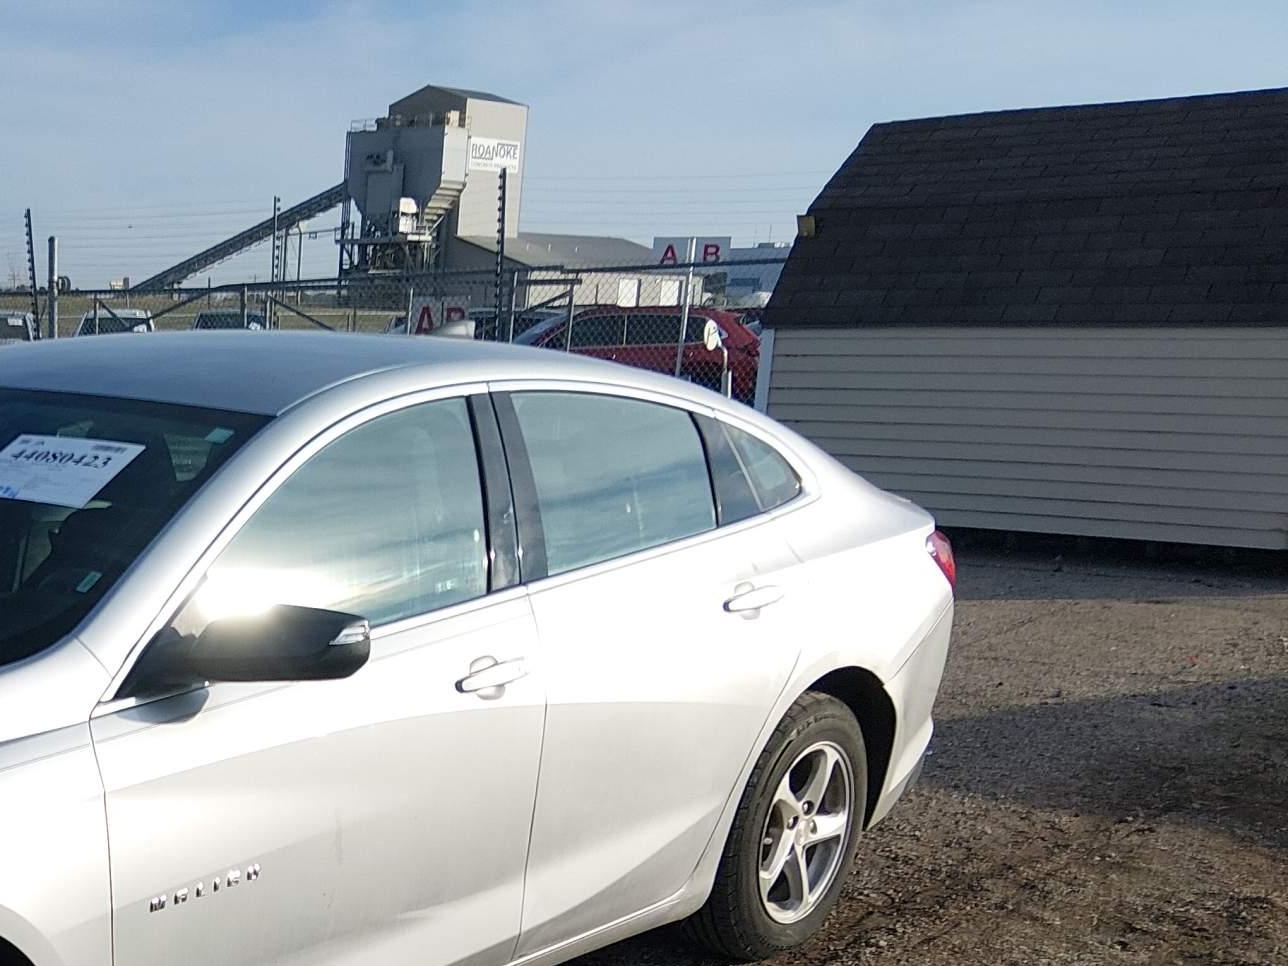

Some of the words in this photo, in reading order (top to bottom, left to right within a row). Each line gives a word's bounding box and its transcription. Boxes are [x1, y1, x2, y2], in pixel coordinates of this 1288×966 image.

[472, 143, 518, 160] ROANOKE
[659, 243, 677, 265] A
[703, 243, 720, 264] B
[415, 305, 433, 335] A
[12, 449, 112, 469] 44080423
